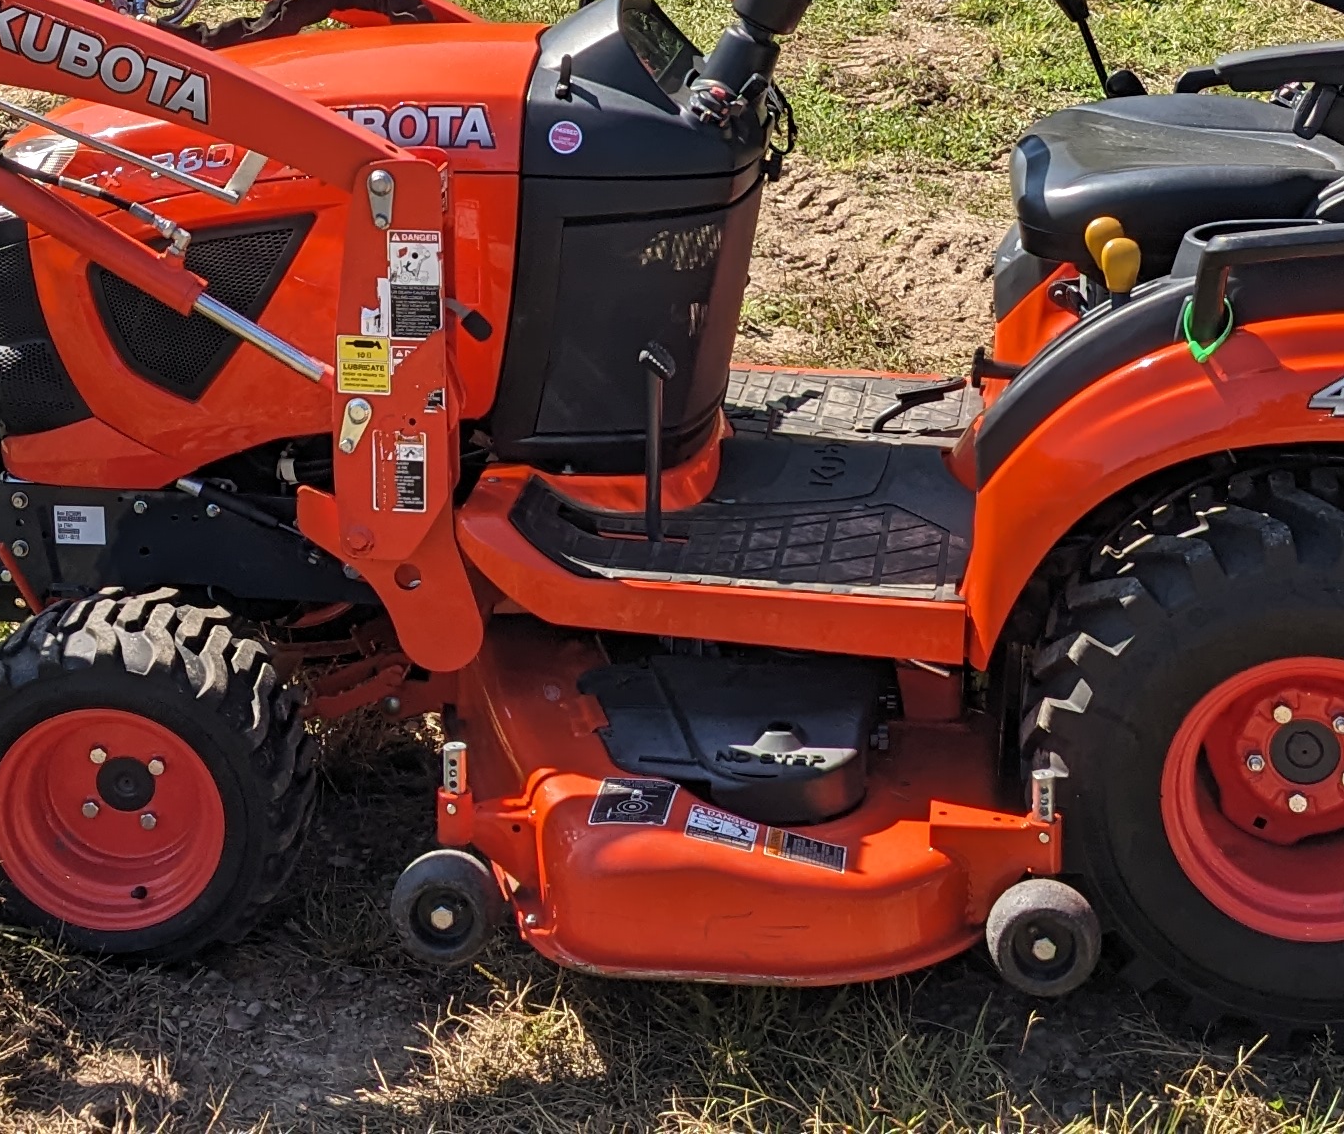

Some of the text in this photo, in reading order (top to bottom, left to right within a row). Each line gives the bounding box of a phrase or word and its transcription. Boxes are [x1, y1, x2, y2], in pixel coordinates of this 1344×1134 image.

[336, 105, 496, 149] BOTA
[401, 233, 438, 242] DANGER
[342, 363, 385, 372] LUBRICATE
[715, 750, 826, 767] NO STEP
